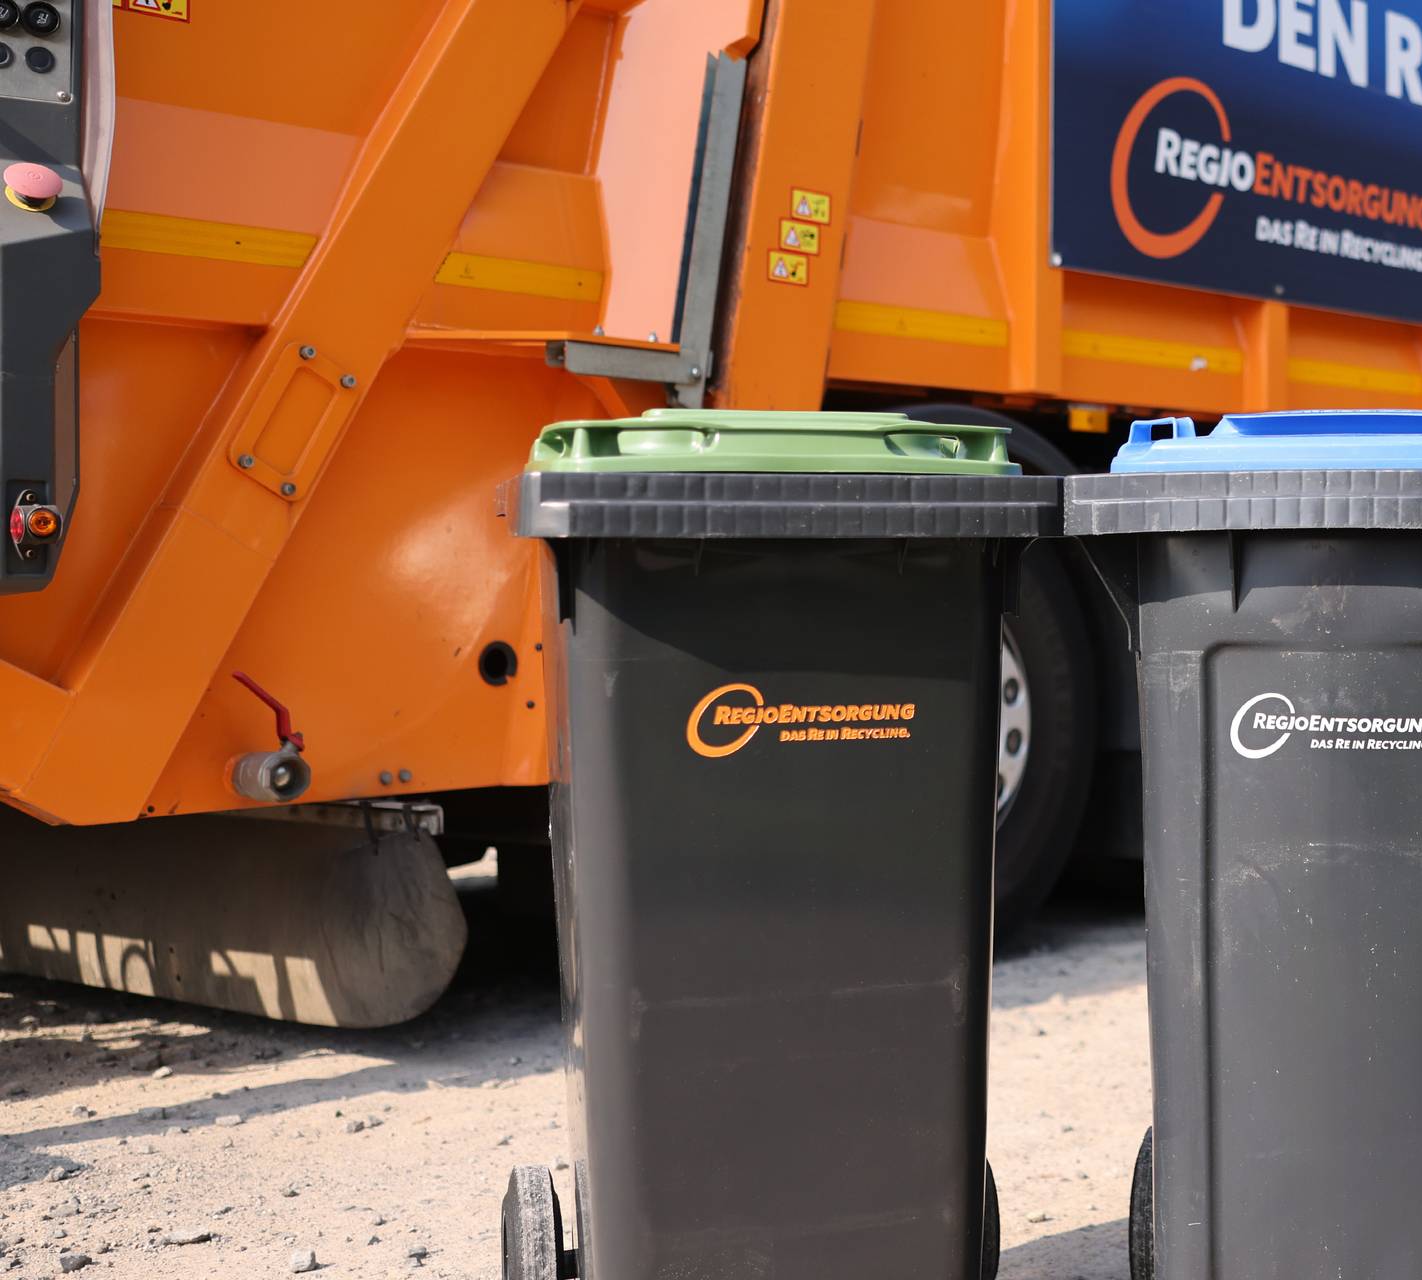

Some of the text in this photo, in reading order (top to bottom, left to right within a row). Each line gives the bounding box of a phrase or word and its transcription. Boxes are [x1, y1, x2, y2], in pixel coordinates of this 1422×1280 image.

[1222, 0, 1370, 89] DEN
[1255, 215, 1293, 247] DAS
[779, 729, 807, 742] DAS
[807, 727, 826, 742] RE
[825, 728, 839, 741] IN
[1309, 738, 1334, 750] DAS
[1334, 738, 1351, 750] RE
[1352, 739, 1366, 750] IN
